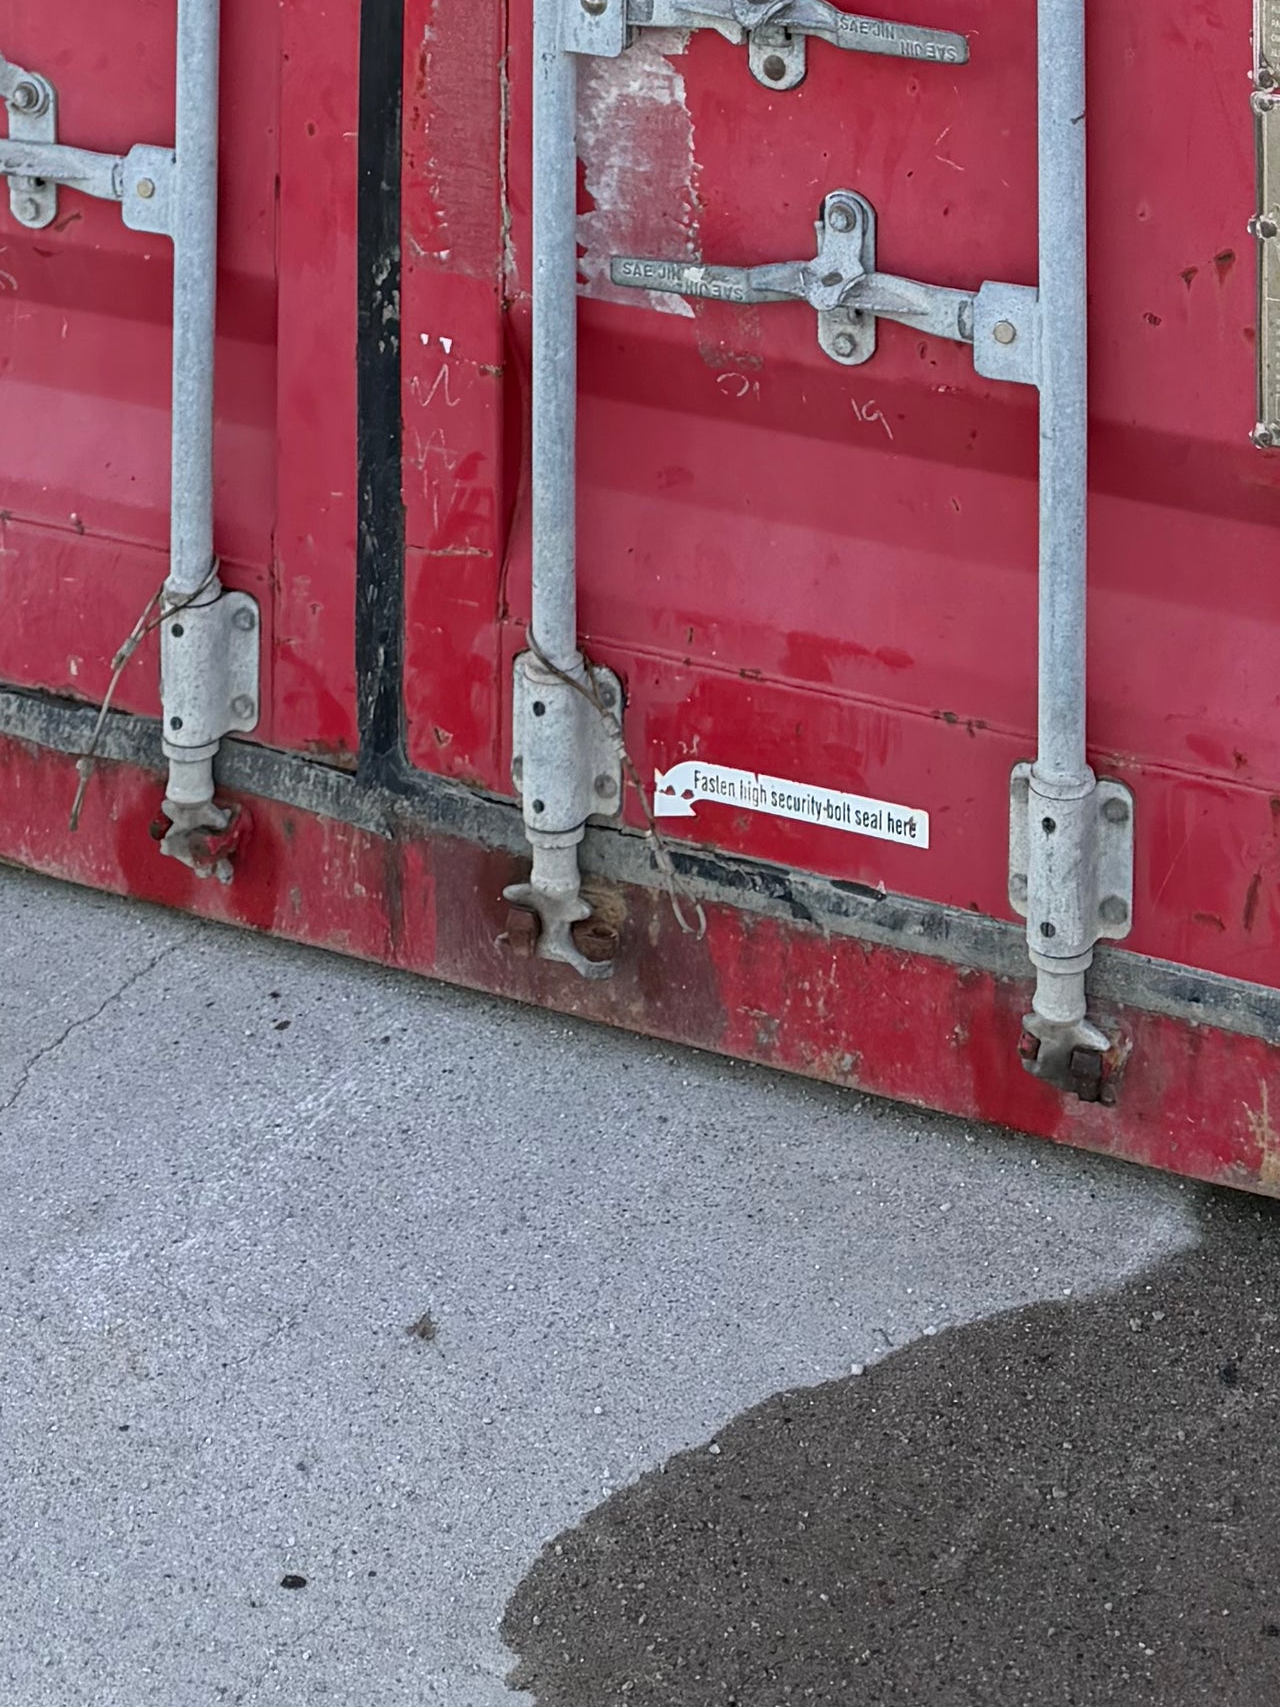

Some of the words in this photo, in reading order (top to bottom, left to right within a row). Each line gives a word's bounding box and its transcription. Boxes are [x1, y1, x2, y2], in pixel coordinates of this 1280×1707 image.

[771, 793, 851, 824] security-bolt
[855, 810, 882, 830] seal
[887, 812, 917, 838] here
